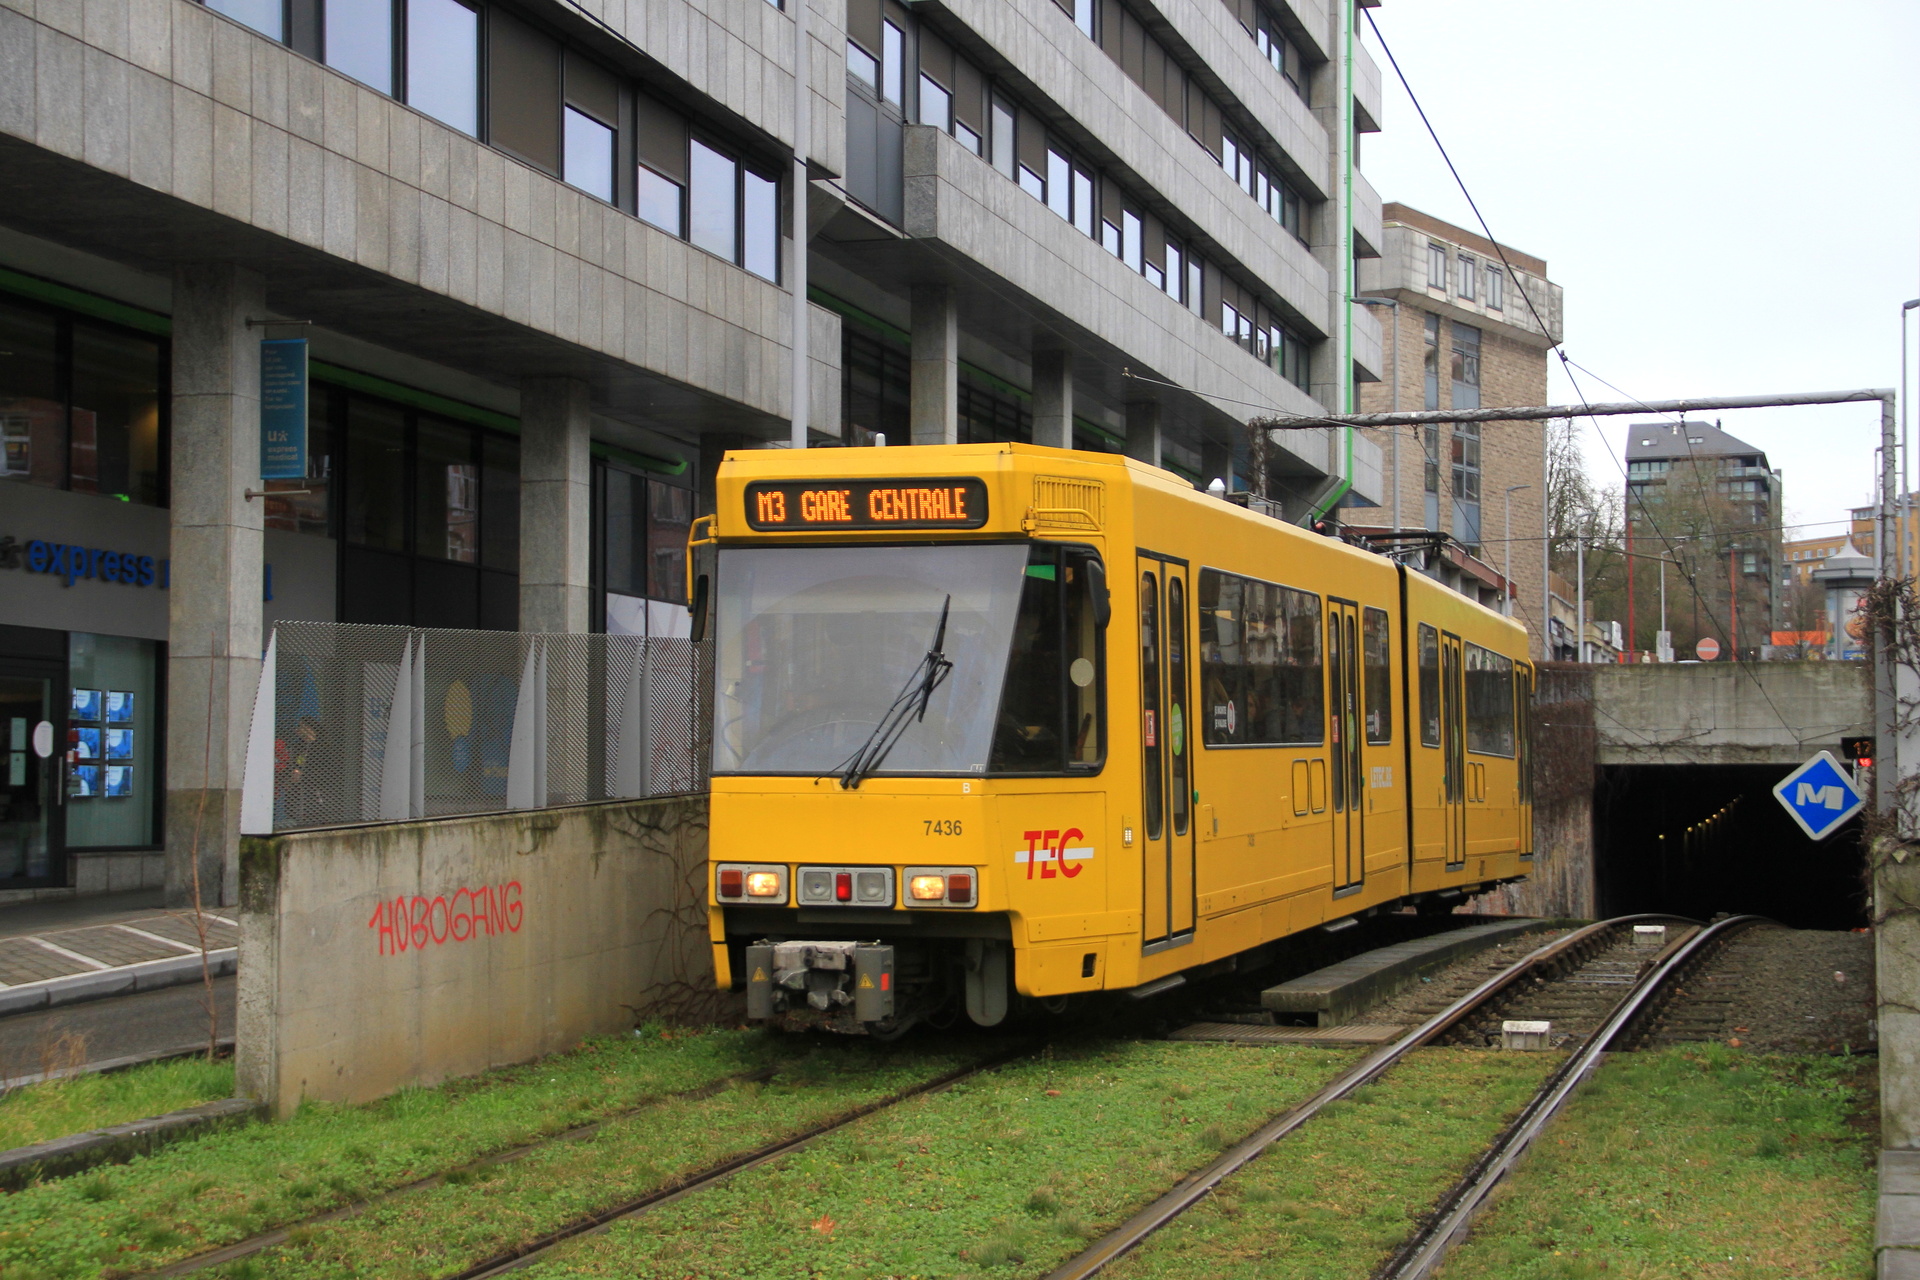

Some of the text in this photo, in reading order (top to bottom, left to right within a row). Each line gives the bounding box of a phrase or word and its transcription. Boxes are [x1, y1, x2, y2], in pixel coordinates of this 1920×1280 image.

[757, 487, 967, 522] M3 GARE CENTRALE
[28, 539, 155, 587] express
[962, 782, 971, 793] B
[923, 820, 963, 836] 7436
[1023, 827, 1084, 880] TEC
